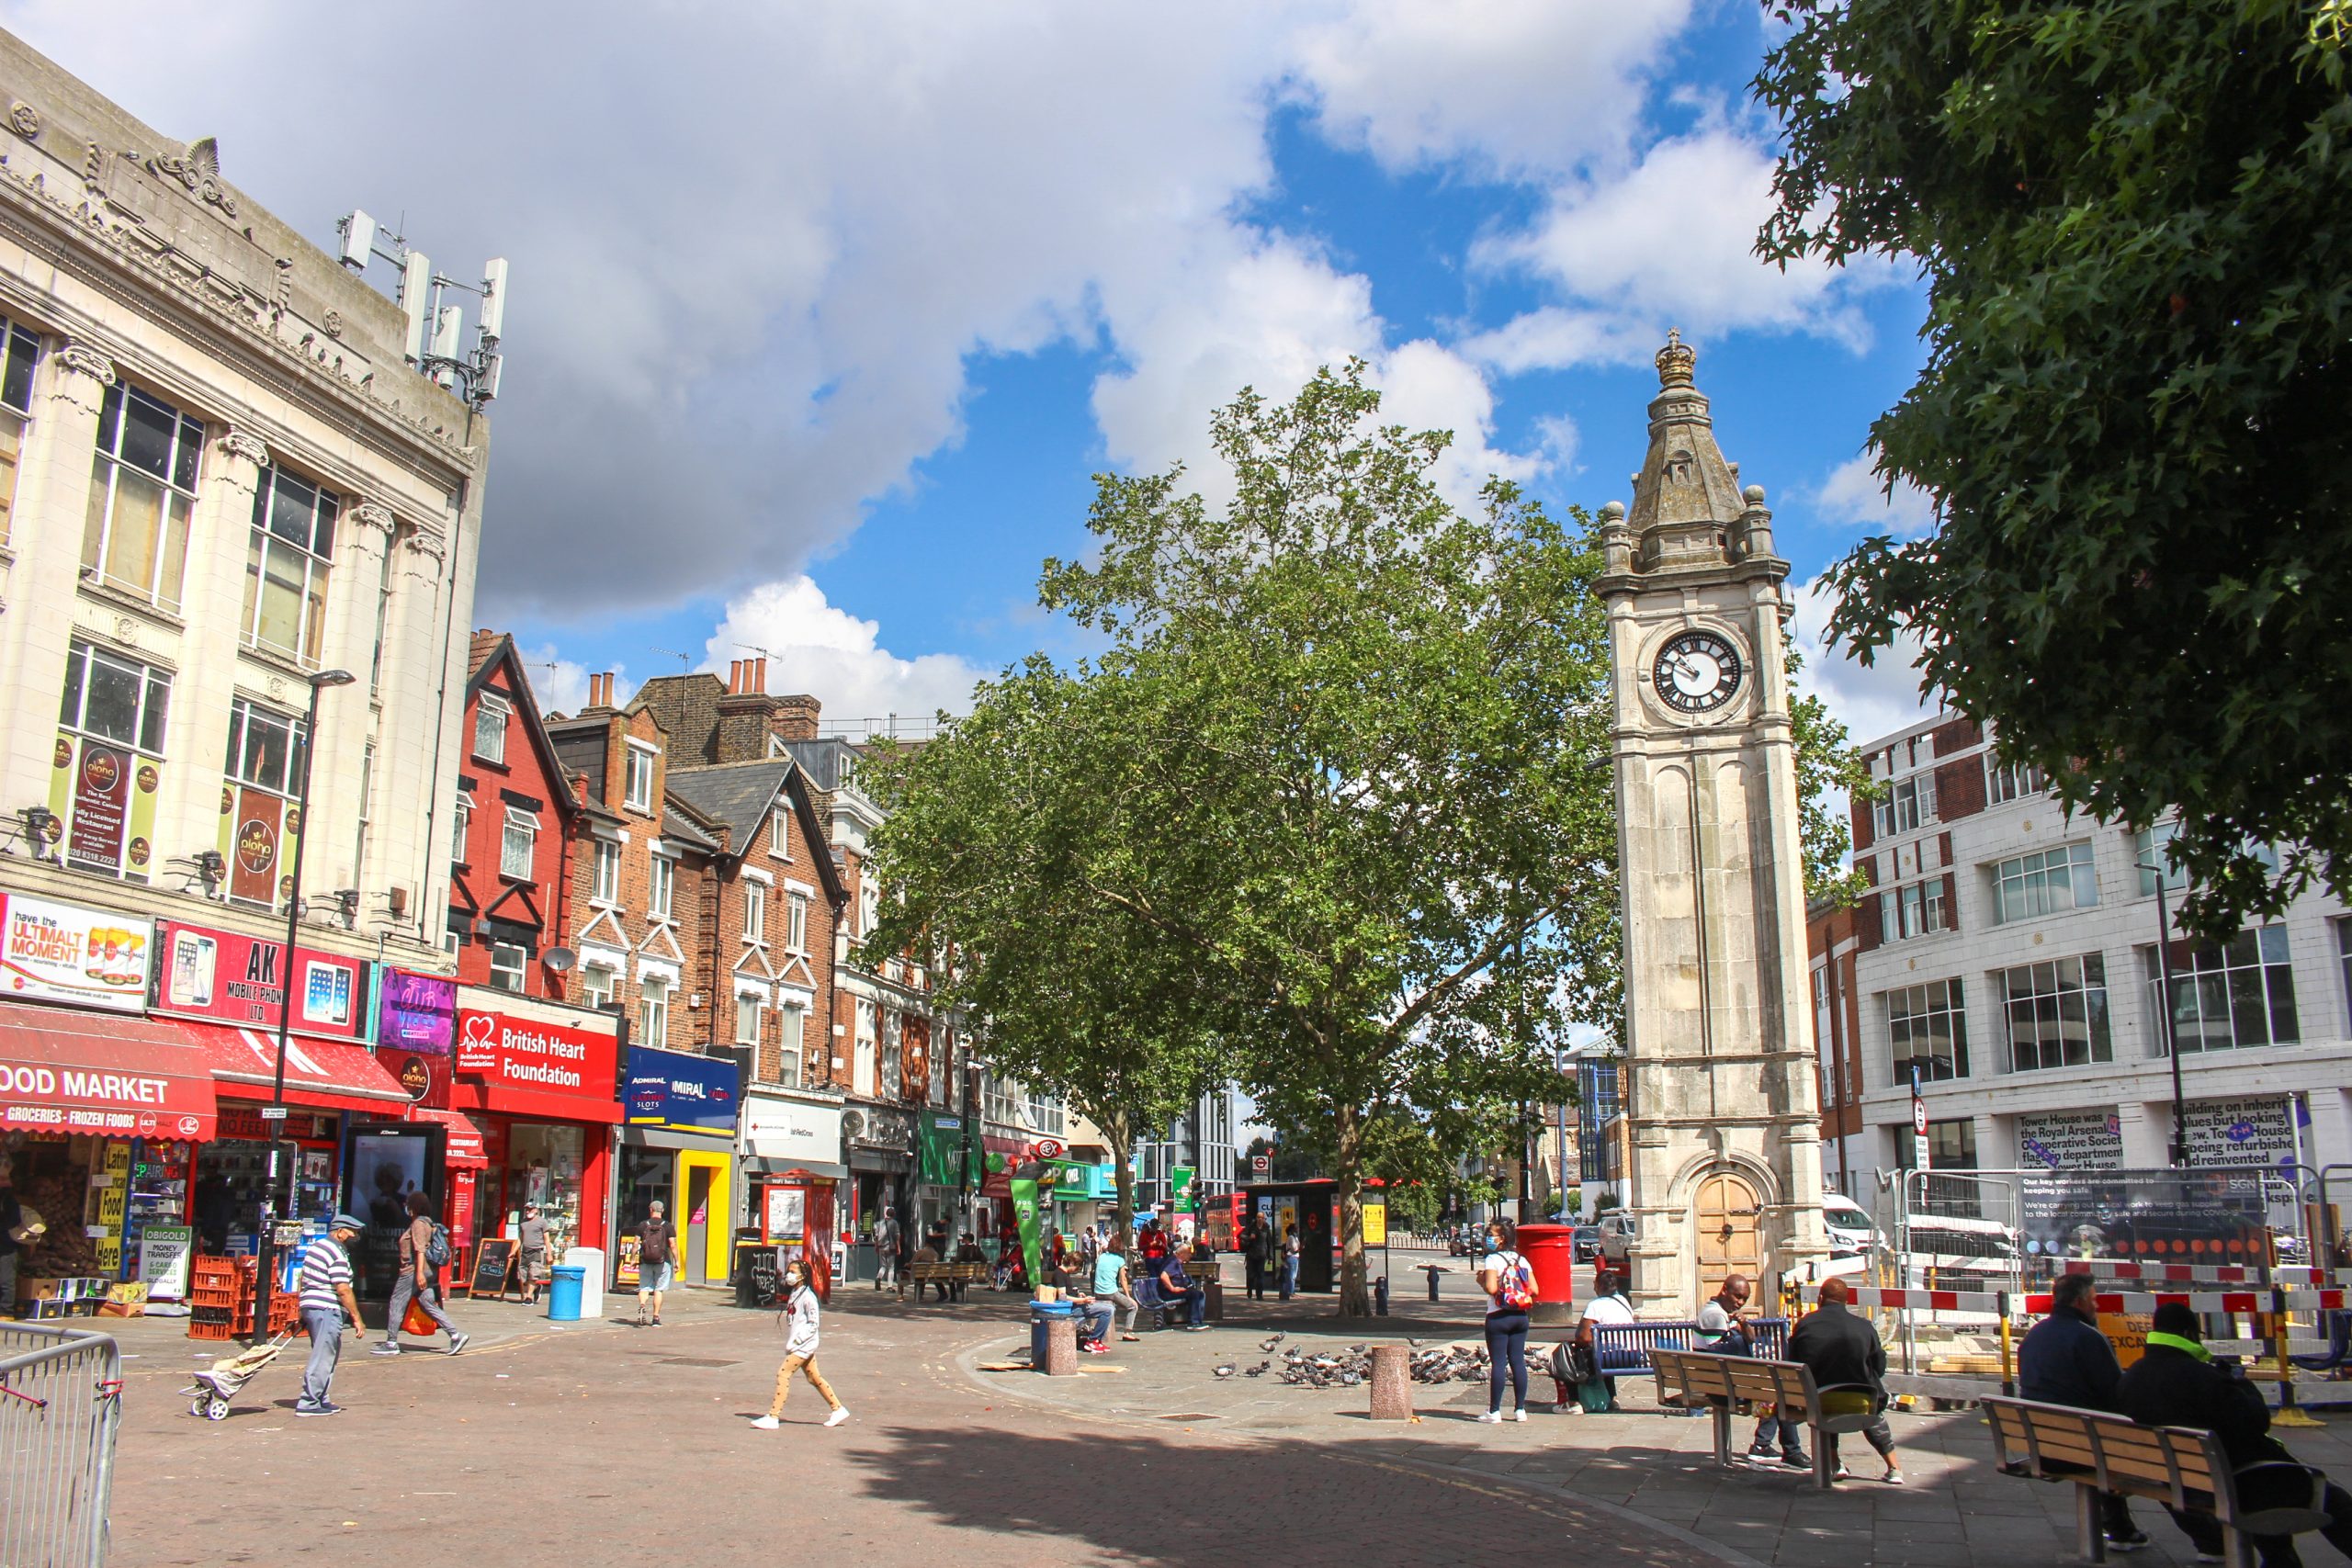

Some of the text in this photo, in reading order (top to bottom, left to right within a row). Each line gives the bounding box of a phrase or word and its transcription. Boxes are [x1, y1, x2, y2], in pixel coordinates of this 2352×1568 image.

[99, 793, 111, 801] Best
[102, 801, 122, 811] Cuisine
[76, 817, 114, 831] Restaurant
[90, 810, 121, 825] Licensed
[99, 835, 119, 846] Service
[82, 851, 98, 862] 8318
[99, 854, 117, 865] 2222
[15, 911, 57, 927] have the
[13, 920, 84, 948] ULTIMALT
[11, 938, 81, 964] MOMENT
[246, 942, 278, 985] AK
[228, 981, 288, 1006] MOBILE PHON
[250, 1004, 266, 1021] LTD.
[502, 1028, 585, 1060] British Heart
[503, 1057, 581, 1087] Foundation
[62, 1070, 168, 1103] MARKET
[672, 1080, 707, 1100] MIRAL
[2226, 1102, 2241, 1111] on
[7, 1107, 135, 1128] GROCERIES FROZEN FOODS
[2019, 1114, 2103, 1127] Tower House was
[2213, 1115, 2234, 1126] but
[2238, 1111, 2285, 1126] looking
[241, 1120, 263, 1134] FEE
[2021, 1128, 2037, 1139] the
[2039, 1125, 2065, 1140] Royal
[2068, 1122, 2108, 1136] Arsenal
[2253, 1125, 2291, 1137] House
[2088, 1134, 2122, 1146] Societ
[106, 1147, 128, 1169] Latin
[2064, 1146, 2123, 1163] department
[2202, 1152, 2270, 1166] reinvented
[2040, 1178, 2053, 1186] key
[2229, 1179, 2256, 1190] SGN
[2023, 1187, 2055, 1195] keeping
[102, 1191, 122, 1216] Food
[2049, 1202, 2079, 1211] carrying
[147, 1231, 187, 1240] OBIGOLD
[97, 1241, 119, 1267] Here
[2127, 1321, 2153, 1333] DEE
